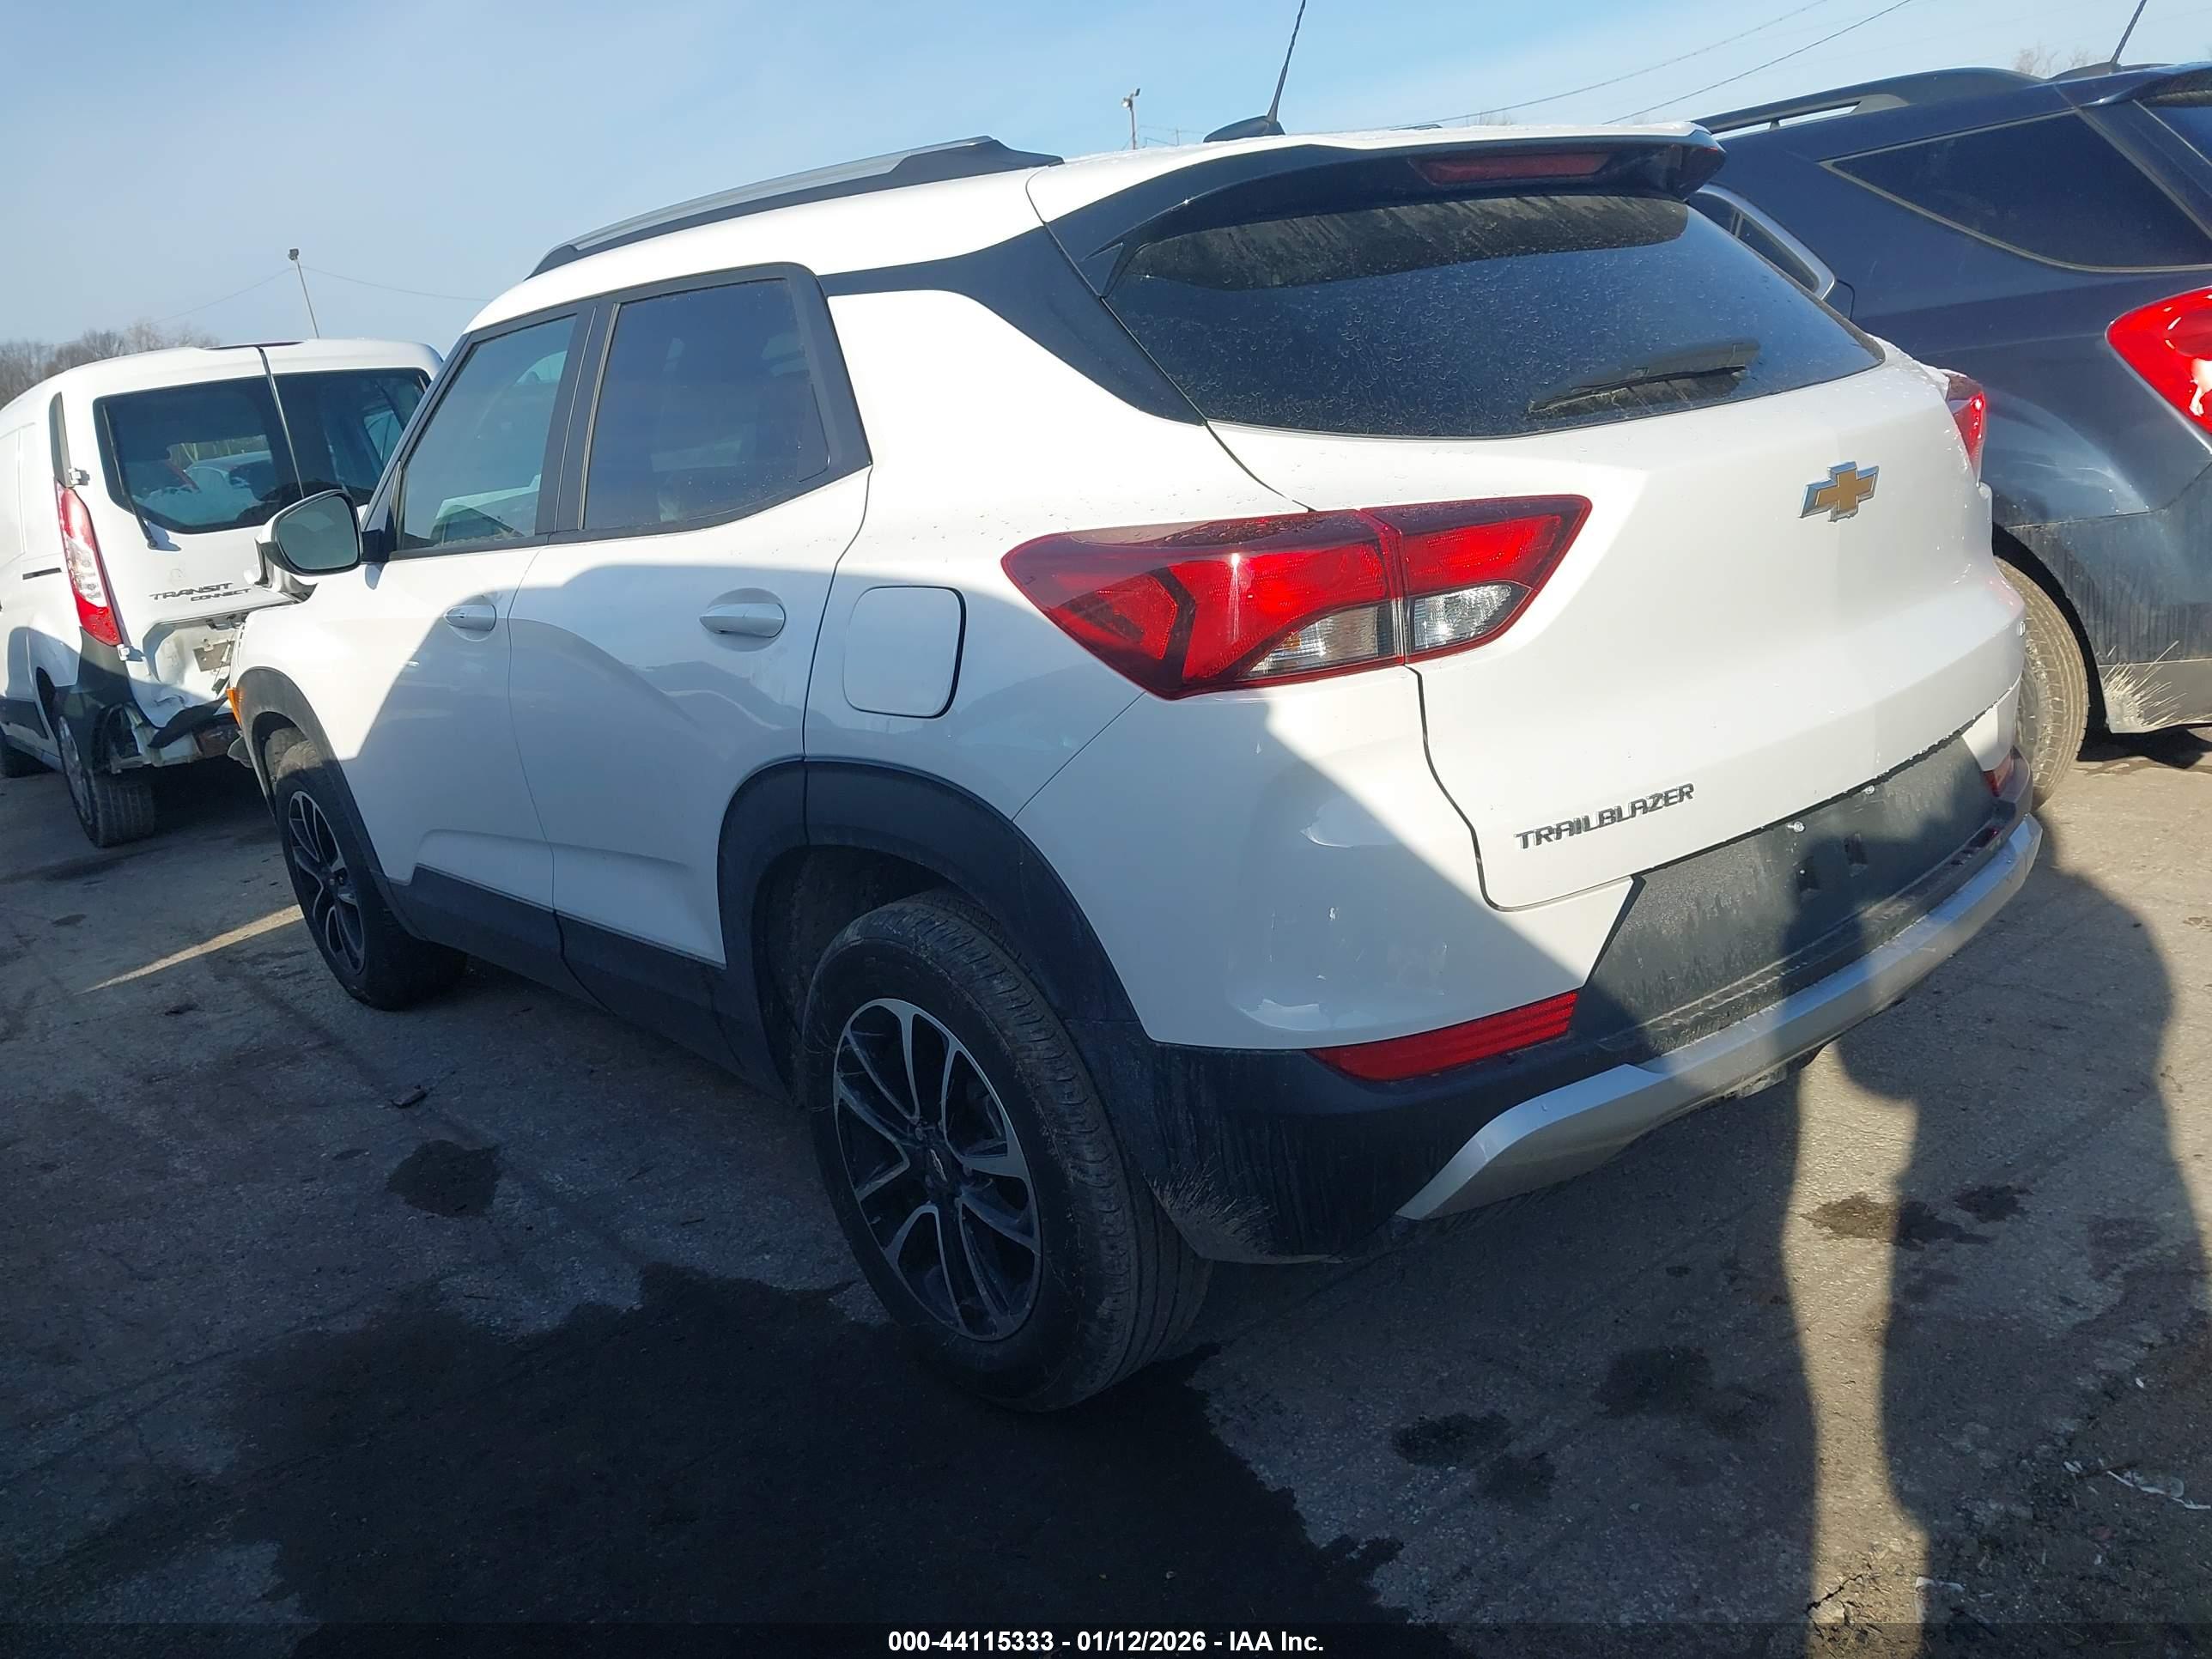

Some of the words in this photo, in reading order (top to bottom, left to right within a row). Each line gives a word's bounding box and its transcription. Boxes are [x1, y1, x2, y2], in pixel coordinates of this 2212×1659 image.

[149, 582, 234, 600] TRANSIT
[191, 587, 251, 602] CONNECT
[1514, 782, 1695, 849] TRAILBLAZER
